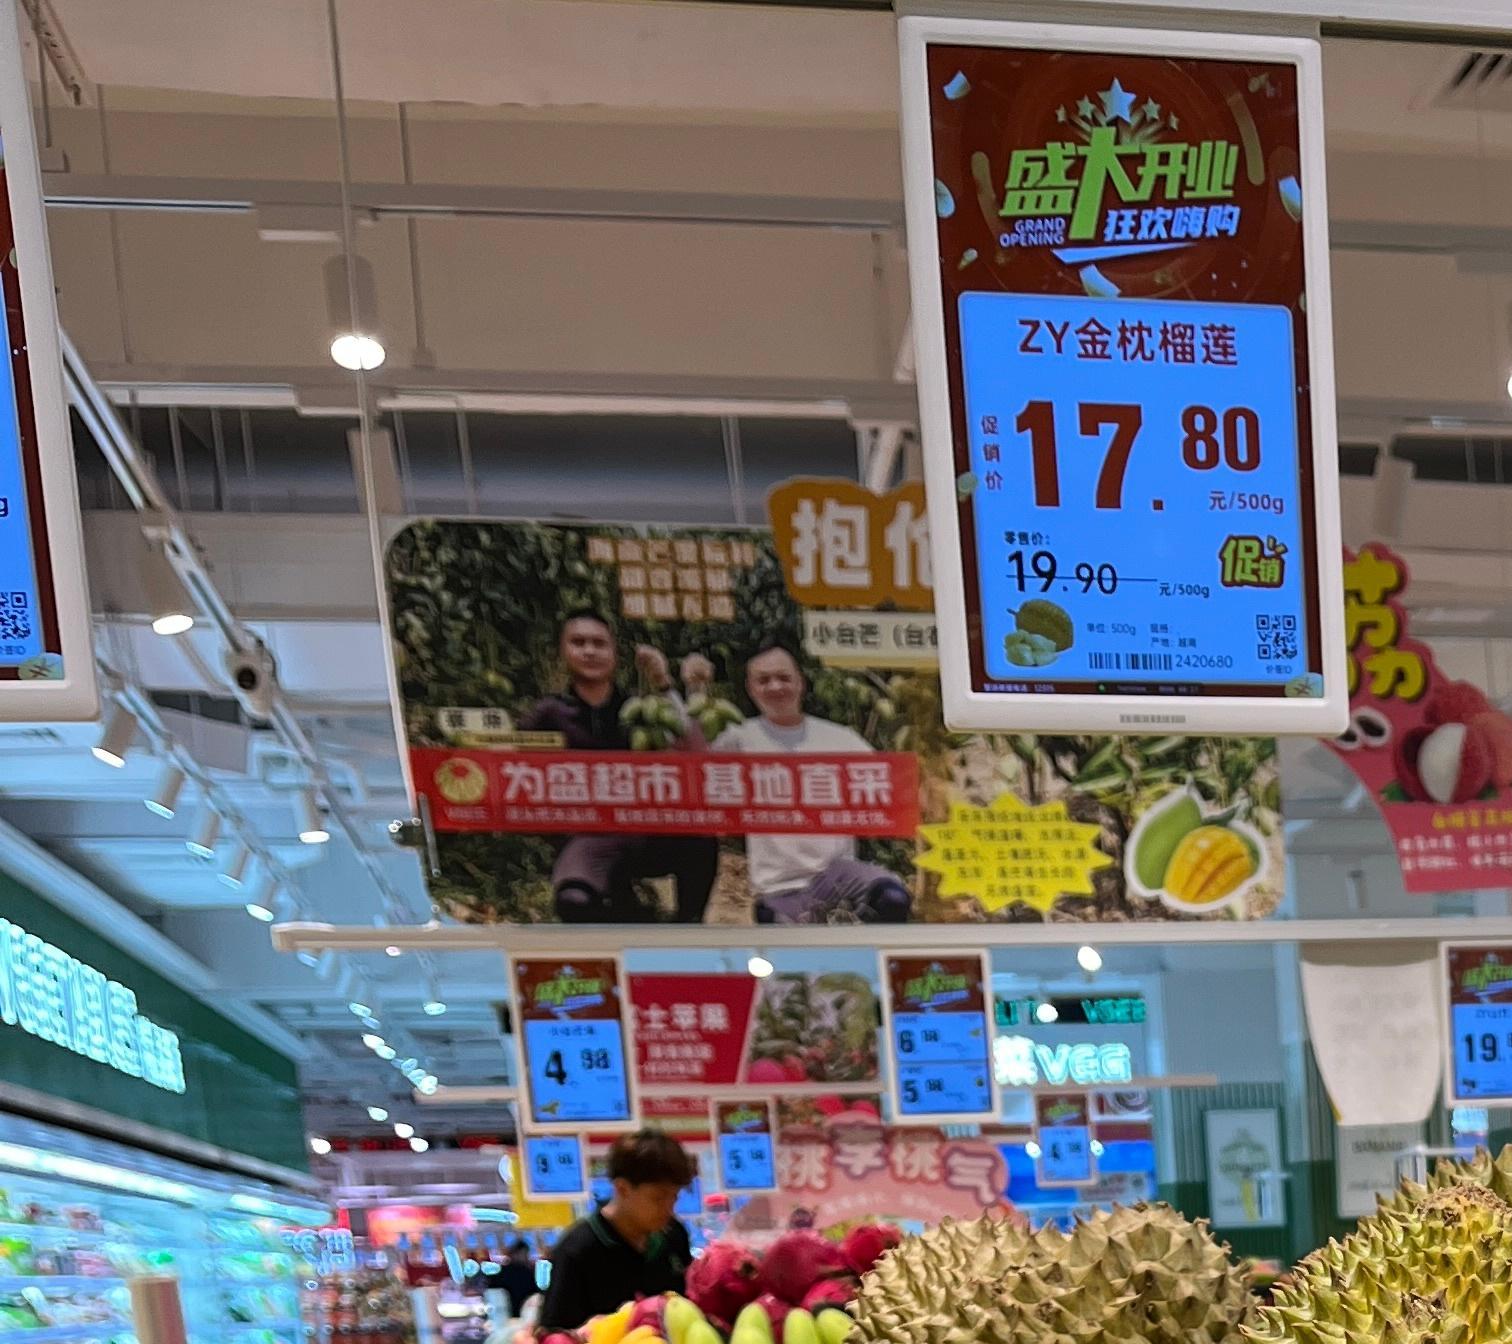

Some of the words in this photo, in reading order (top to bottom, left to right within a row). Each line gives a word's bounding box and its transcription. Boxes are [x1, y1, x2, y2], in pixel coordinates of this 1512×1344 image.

[999, 126, 1240, 240] 盛大开业
[1014, 218, 1066, 234] GRAND
[1104, 205, 1240, 241] 狂欢嗨购
[999, 231, 1065, 248] OPENING
[1018, 316, 1240, 368] ZY金枕榴莲
[1208, 490, 1285, 514] 元/500g
[1007, 549, 1118, 595] 19.90
[1158, 581, 1211, 599] 元/500g
[1174, 654, 1234, 670] 2420680
[501, 761, 682, 804] 为盛超市
[702, 761, 892, 806] 基地直采
